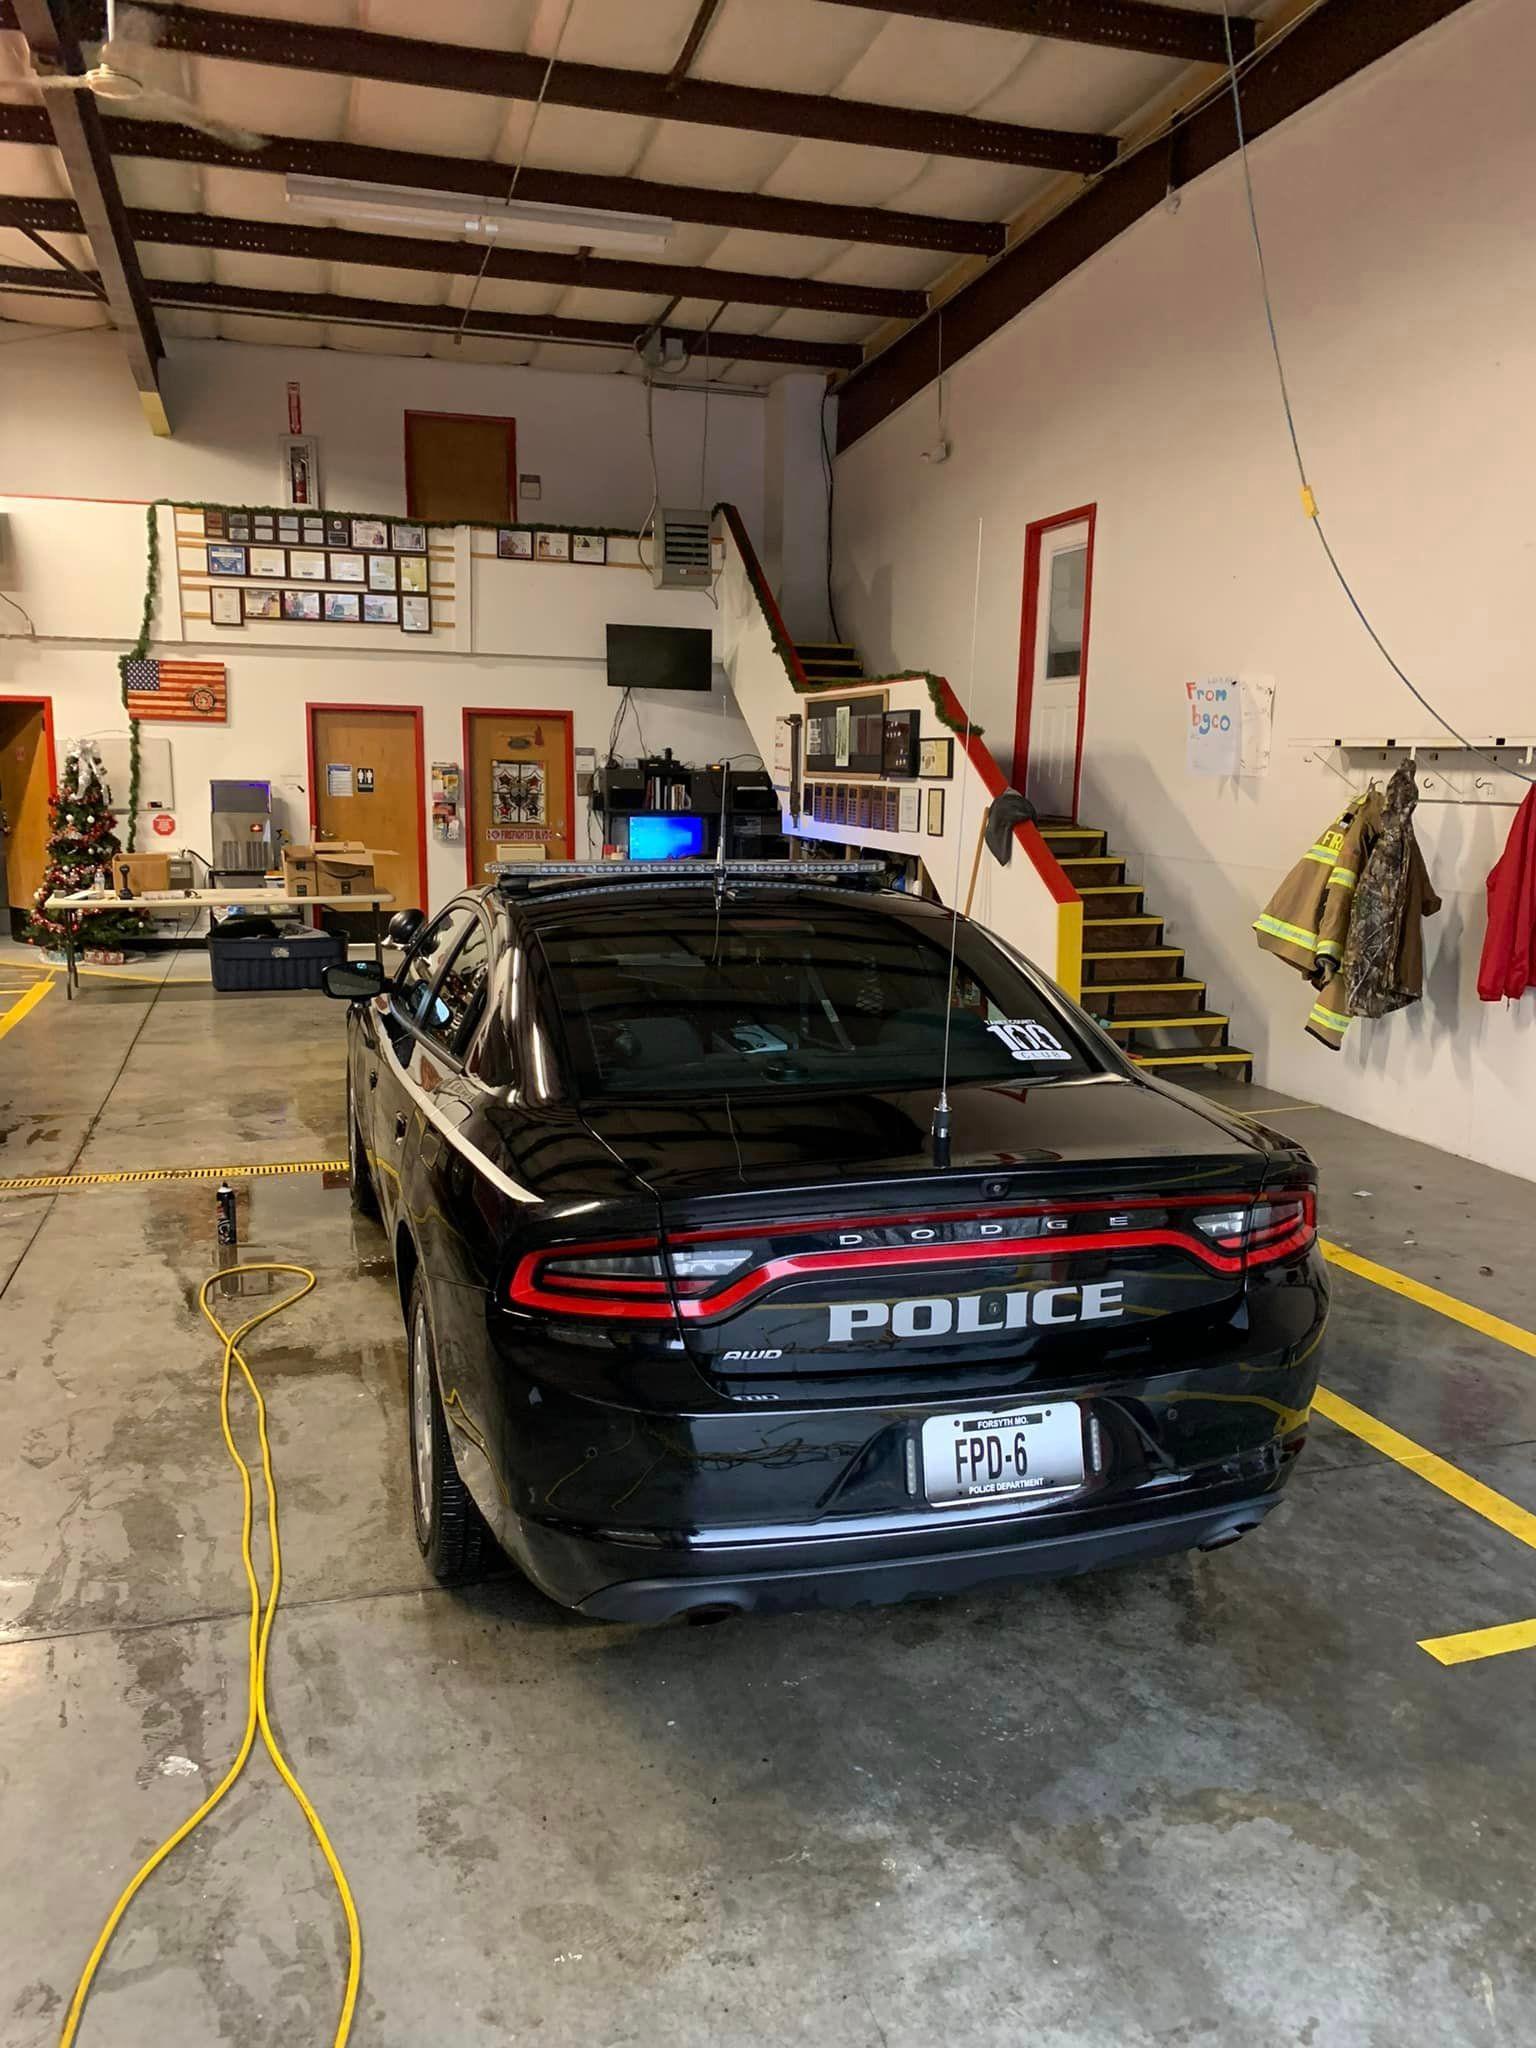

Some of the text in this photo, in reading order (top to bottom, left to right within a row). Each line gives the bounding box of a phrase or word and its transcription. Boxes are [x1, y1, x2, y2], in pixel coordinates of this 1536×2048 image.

[1186, 682, 1227, 701] From
[1322, 830, 1345, 850] FIR
[986, 1024, 1062, 1051] 100
[839, 1215, 1129, 1246] DODGE
[827, 1281, 1125, 1343] POLICE
[722, 1349, 783, 1361] AWD
[977, 1416, 1013, 1429] FORSYTH
[955, 1432, 1028, 1484] FPD-6
[968, 1478, 1044, 1494] POLICE DEPARTMENT
